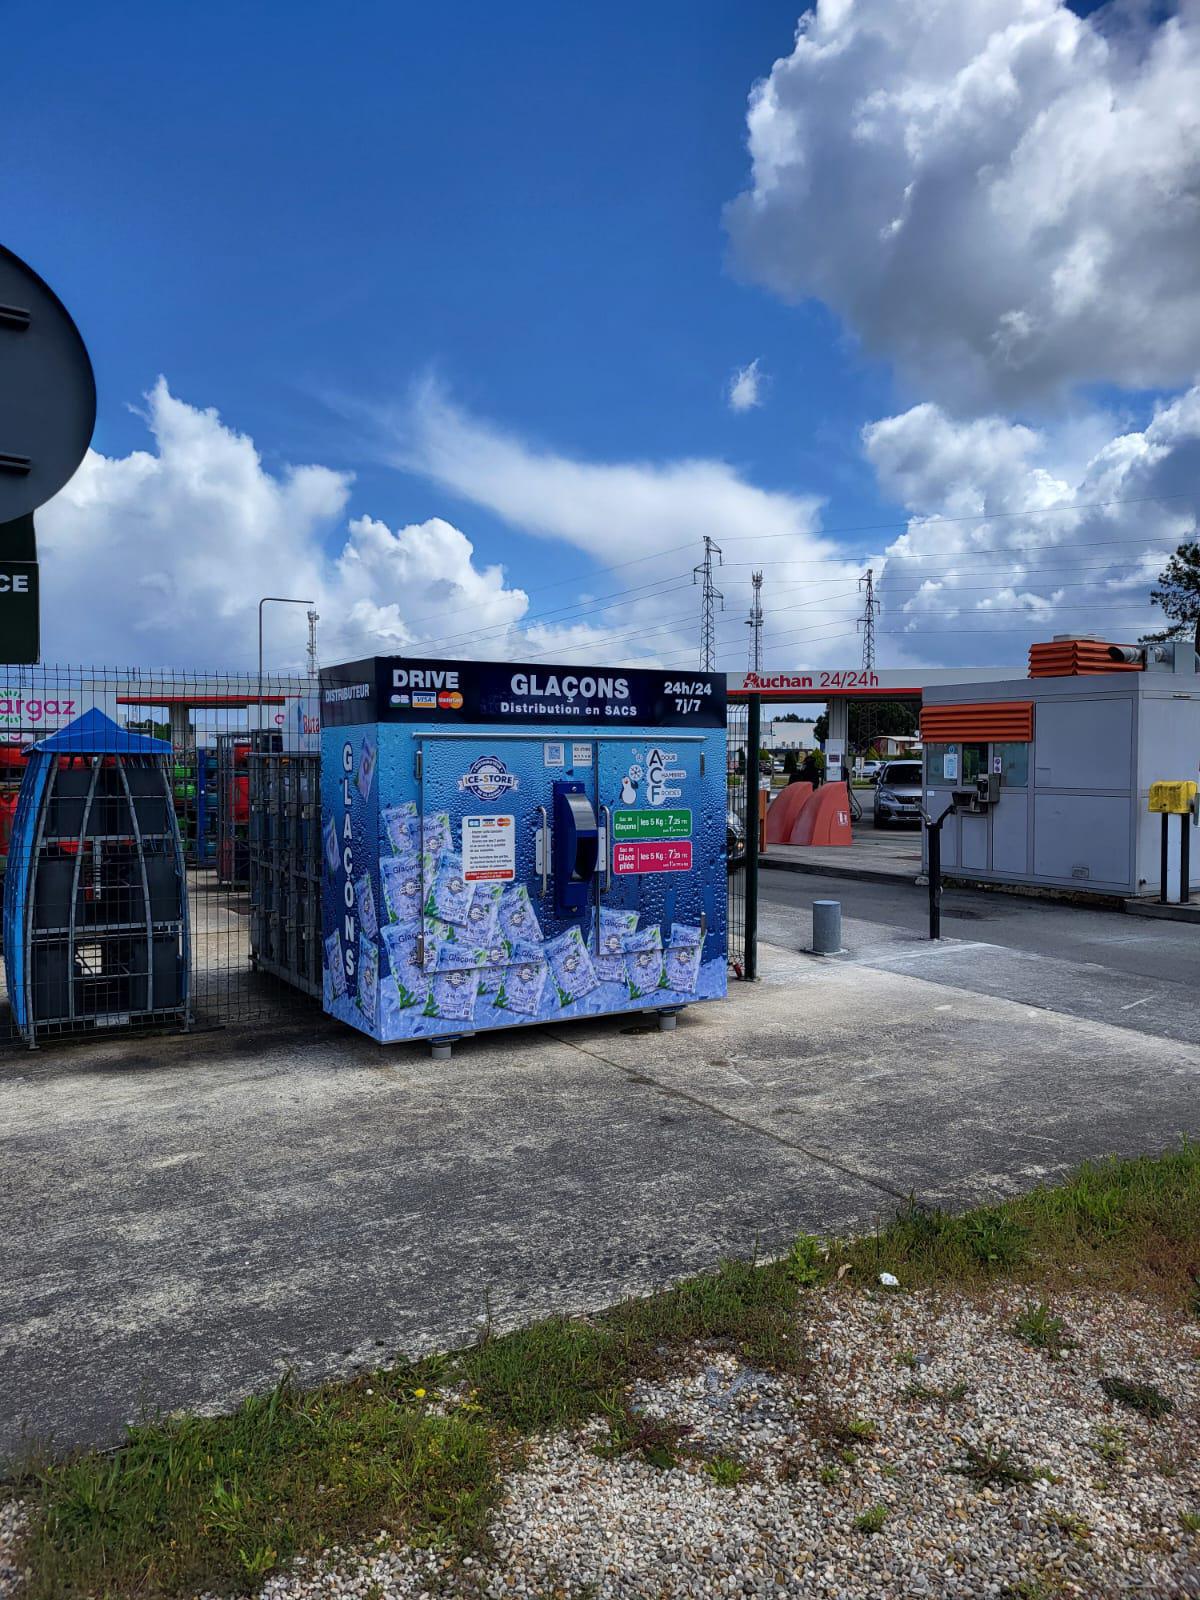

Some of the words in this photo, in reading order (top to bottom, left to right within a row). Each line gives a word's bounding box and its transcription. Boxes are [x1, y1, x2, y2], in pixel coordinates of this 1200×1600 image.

[392, 669, 459, 689] DRIVE
[743, 673, 812, 689] Auchan
[820, 671, 879, 688] 24/24h
[325, 683, 370, 704] DISTRIBUTEUR
[510, 673, 630, 702] GLAÇONS
[664, 681, 713, 696] 24h/24
[500, 702, 580, 715] Distribution
[604, 706, 637, 716] SACS
[675, 699, 701, 714] 7j/7
[464, 775, 513, 785] ICE-STORE
[618, 854, 635, 862] Glace
